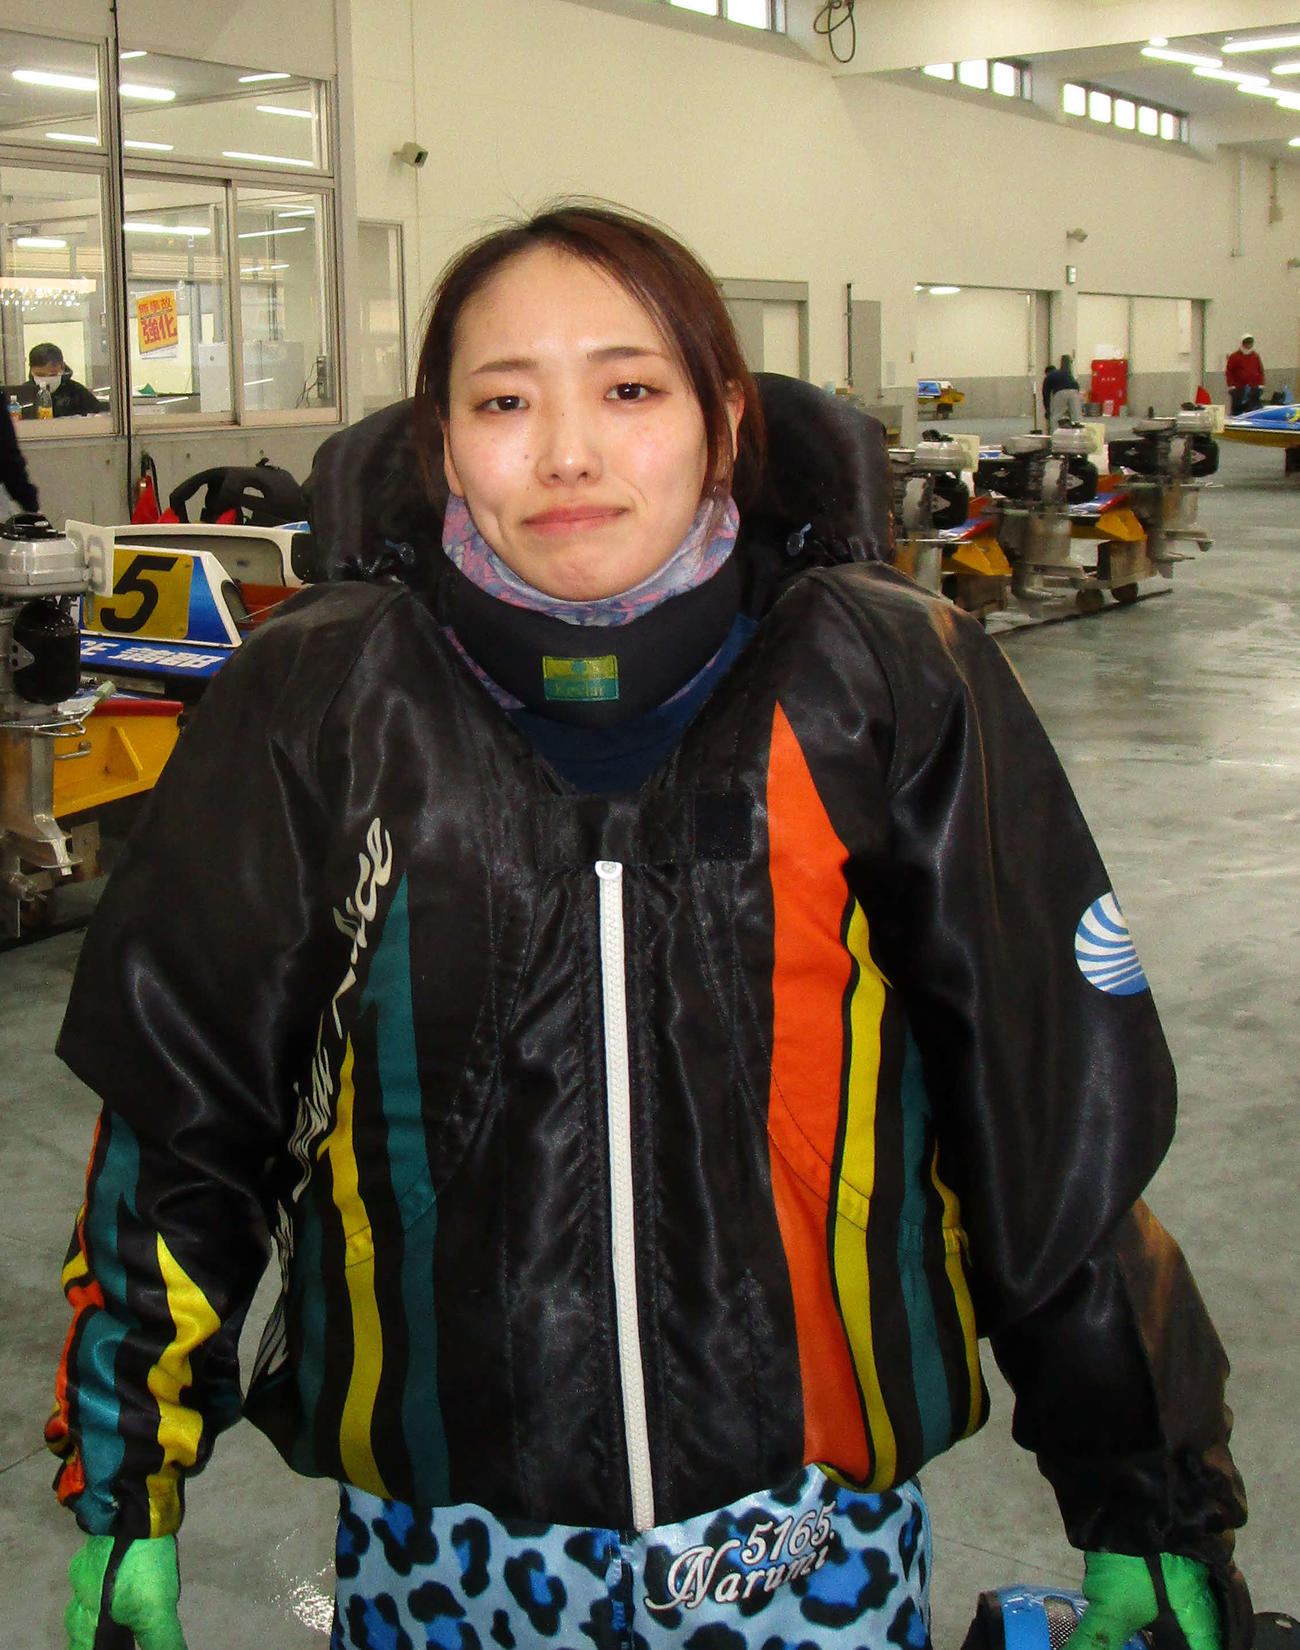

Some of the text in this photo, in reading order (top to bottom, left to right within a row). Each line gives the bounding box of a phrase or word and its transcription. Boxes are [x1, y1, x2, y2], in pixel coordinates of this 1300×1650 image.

[140, 314, 178, 344] 強化
[100, 554, 178, 632] 5
[740, 1500, 836, 1566] 5165
[643, 1529, 835, 1611] Narumi
